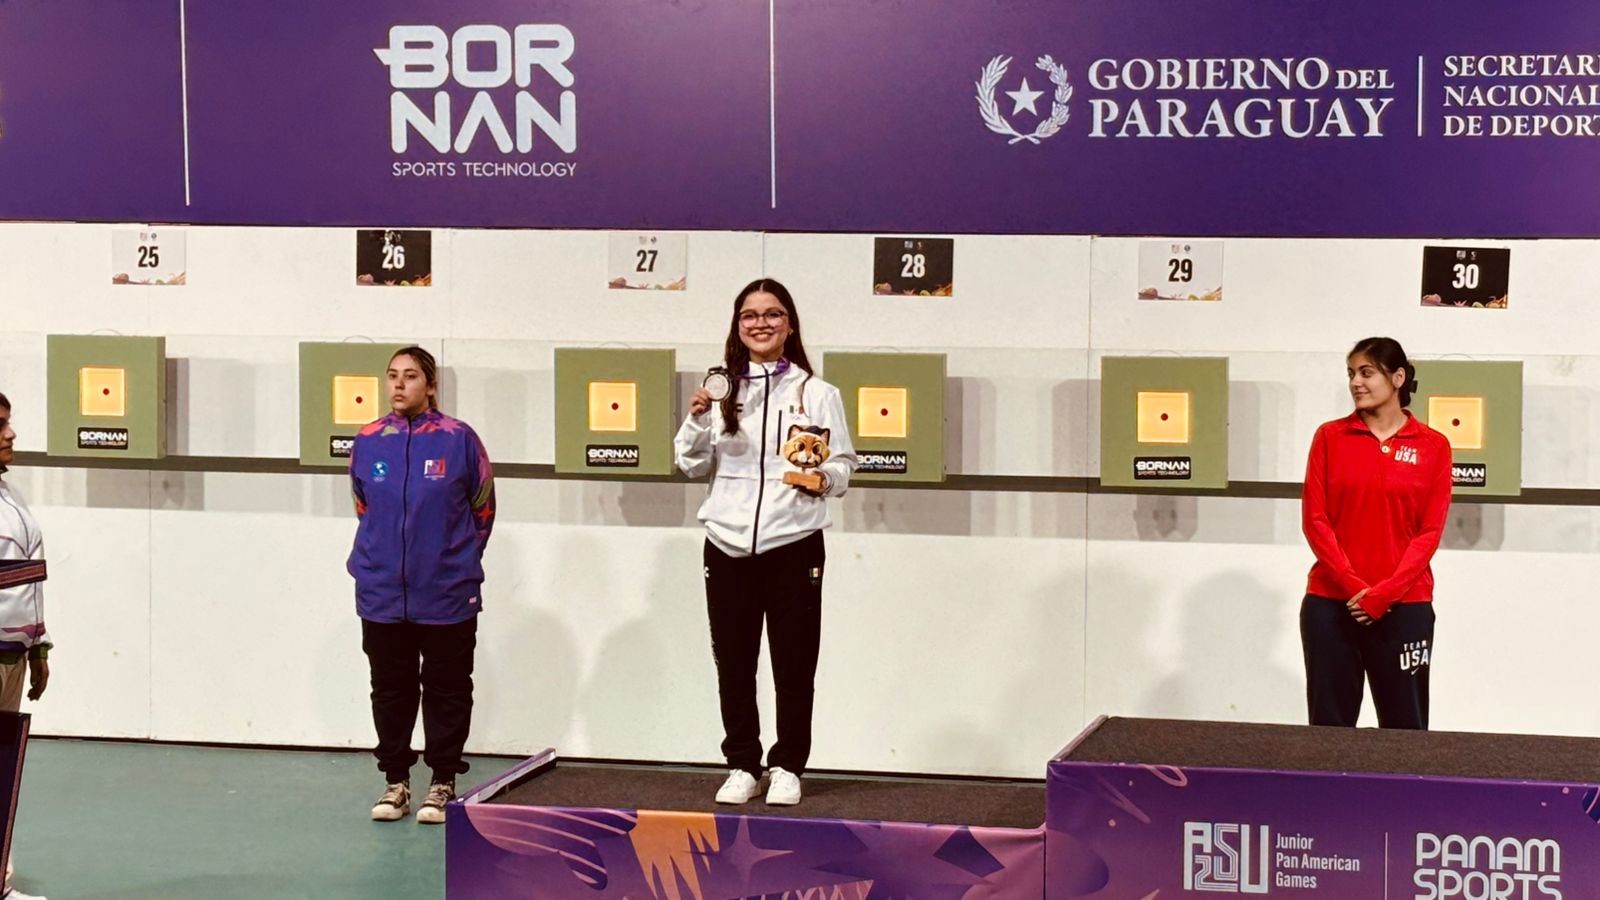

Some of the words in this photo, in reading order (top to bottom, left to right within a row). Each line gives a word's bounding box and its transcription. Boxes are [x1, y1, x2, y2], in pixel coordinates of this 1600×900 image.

[1088, 57, 1329, 90] GOBIERNO
[1335, 69, 1395, 90] DEL
[1443, 85, 1600, 107] NACIONAL
[1088, 97, 1394, 138] PARAGUAY
[1443, 115, 1483, 137] DE
[392, 162, 456, 177] SPORTS
[462, 162, 577, 177] TECHNOLOGY
[138, 246, 159, 268] 25
[382, 245, 405, 269] 26
[636, 249, 658, 272] 27
[901, 254, 926, 278] 28
[1168, 258, 1193, 283] 29
[1452, 263, 1480, 289] 30
[80, 431, 127, 441] BORNAN
[587, 449, 638, 458] BORNAN
[1394, 450, 1417, 465] USA
[1136, 461, 1190, 470] BORNAN
[1403, 640, 1427, 651] TEAM
[1400, 649, 1429, 670] USA
[1275, 833, 1314, 850] Junior
[1416, 832, 1560, 873] PANAM
[1276, 852, 1299, 869] Pan
[1301, 854, 1360, 872] American
[1275, 871, 1317, 889] Games
[1413, 868, 1563, 900] SPORTS
